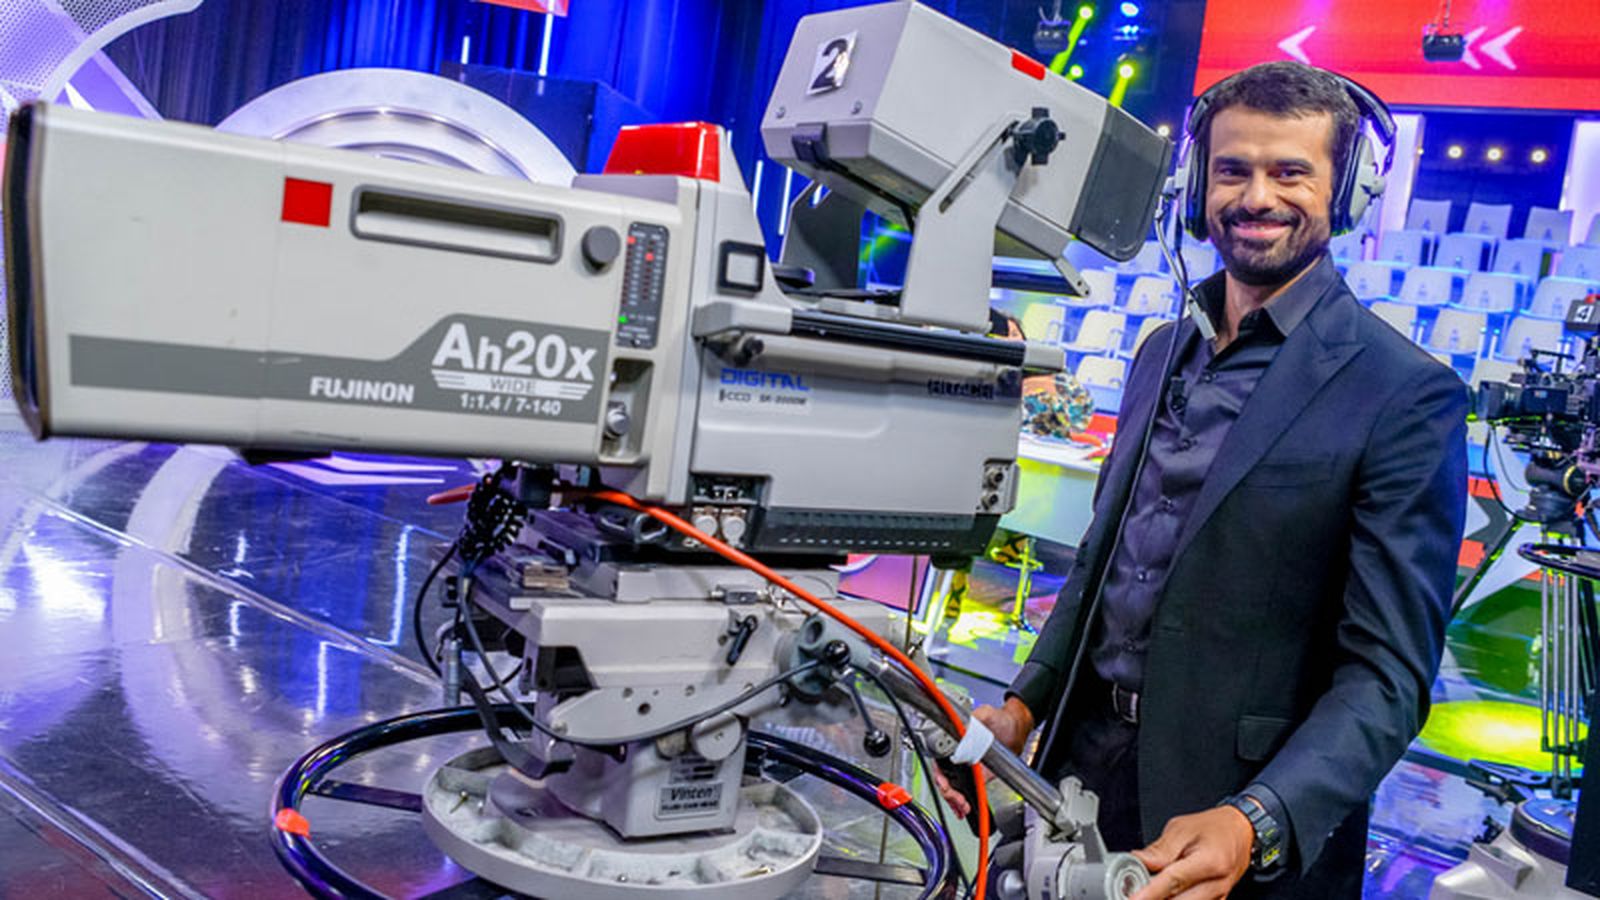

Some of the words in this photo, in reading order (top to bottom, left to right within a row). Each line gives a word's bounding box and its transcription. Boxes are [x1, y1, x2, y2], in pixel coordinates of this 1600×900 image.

[811, 38, 848, 90] 2
[432, 322, 597, 381] Ah20x
[310, 376, 414, 403] FUJINON
[490, 377, 537, 396] WIDE
[720, 368, 809, 391] DIGITAL
[460, 392, 500, 411] 1:1.4
[516, 397, 562, 416] 7-140
[671, 787, 713, 801] Vinten
